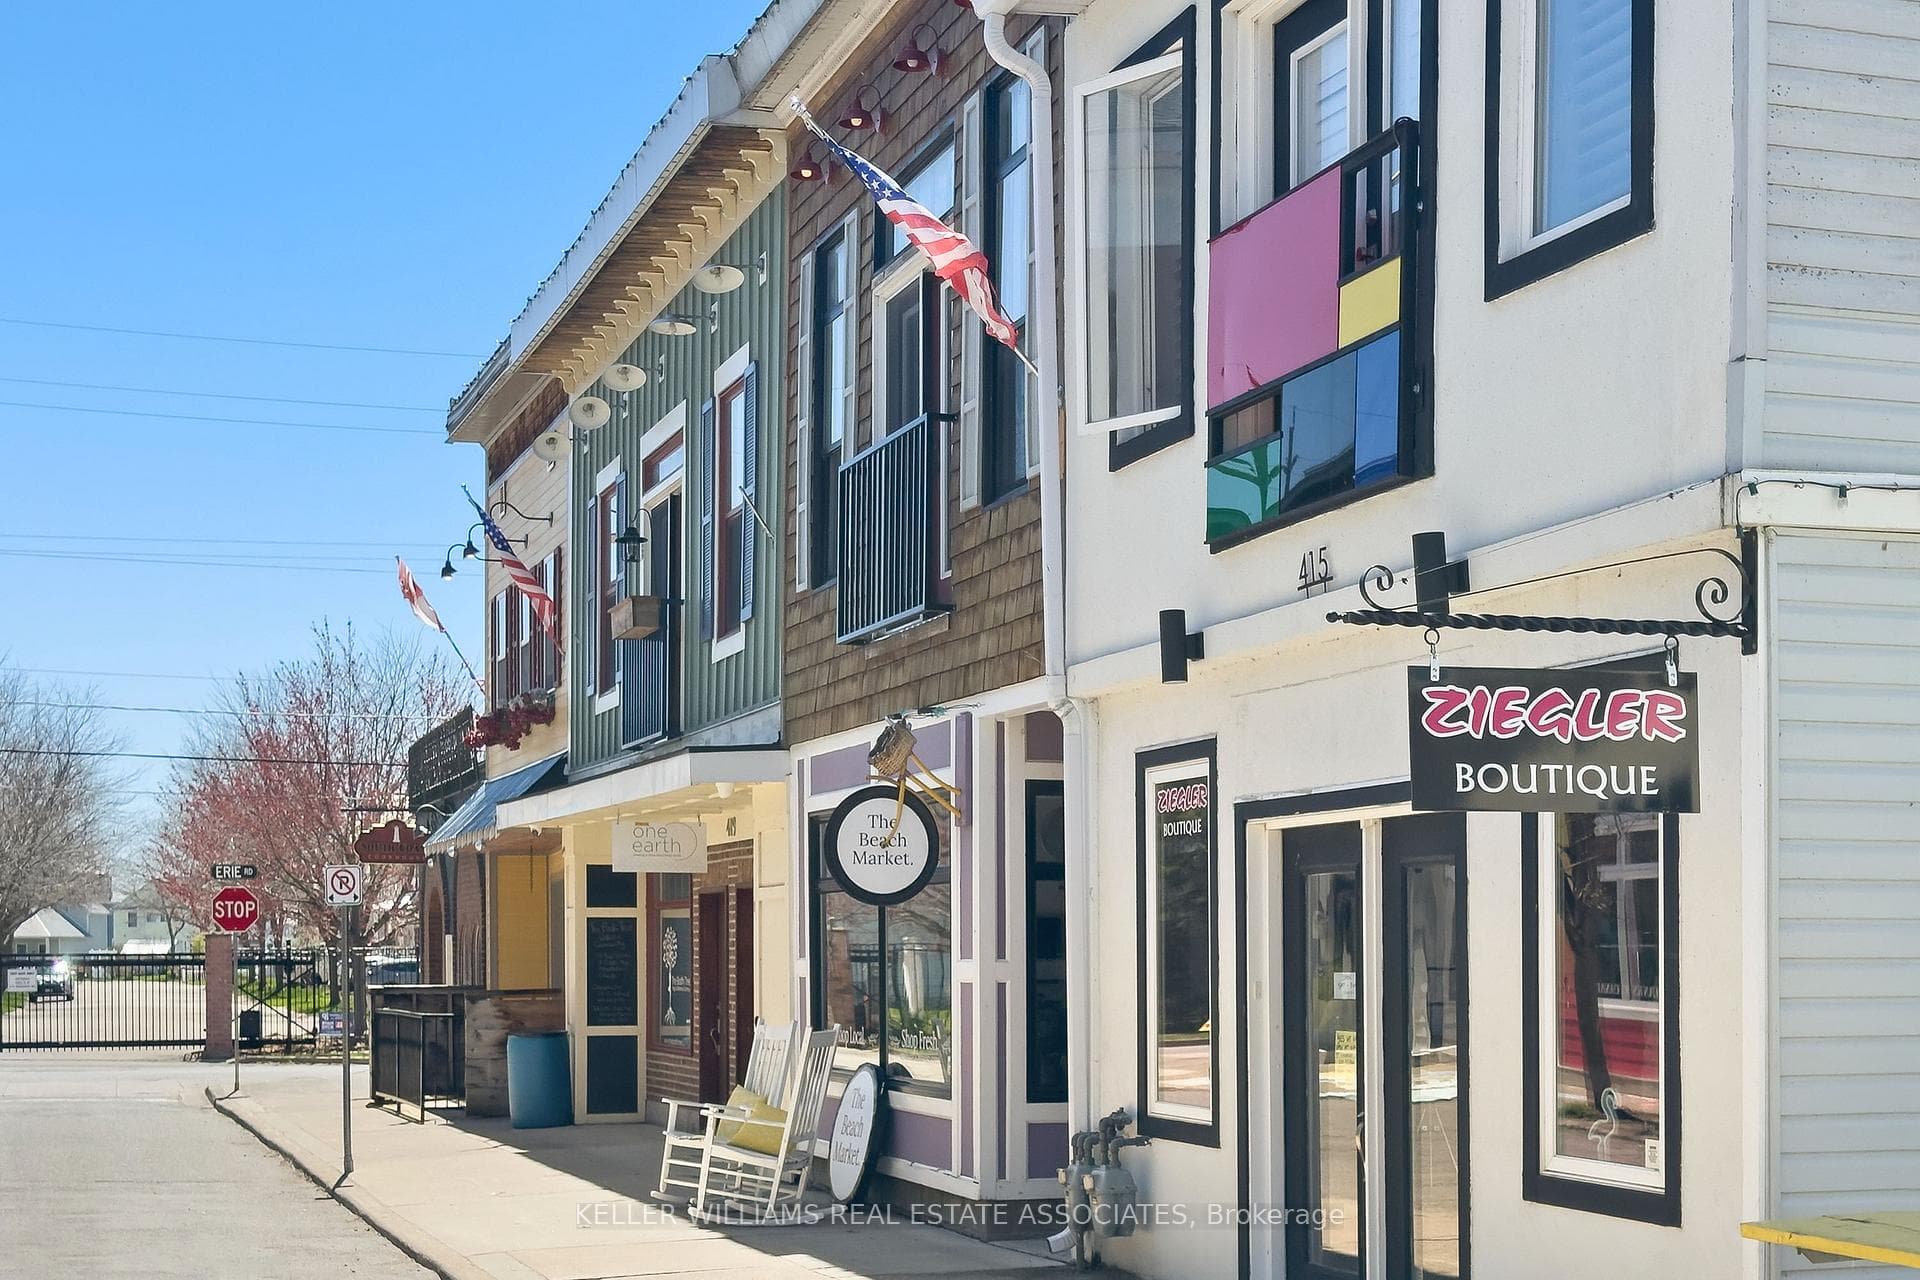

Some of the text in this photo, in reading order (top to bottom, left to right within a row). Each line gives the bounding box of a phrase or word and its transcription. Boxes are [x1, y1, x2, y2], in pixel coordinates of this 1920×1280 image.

[1299, 546, 1328, 599] 415
[1421, 685, 1687, 744] ZIEGLER
[1455, 763, 1659, 799] BOUTIQUE
[1157, 783, 1208, 813] ZIEGLER
[868, 814, 898, 829] The
[1163, 819, 1202, 837] BOUTIQUE
[633, 826, 667, 839] one
[859, 832, 907, 848] Beach
[632, 838, 681, 853] earth
[853, 850, 914, 866] Market.
[215, 865, 242, 879] ERIE
[214, 901, 256, 919] STOP
[901, 1028, 918, 1051] Shop
[851, 1087, 866, 1110] The
[840, 1114, 864, 1138] Beach
